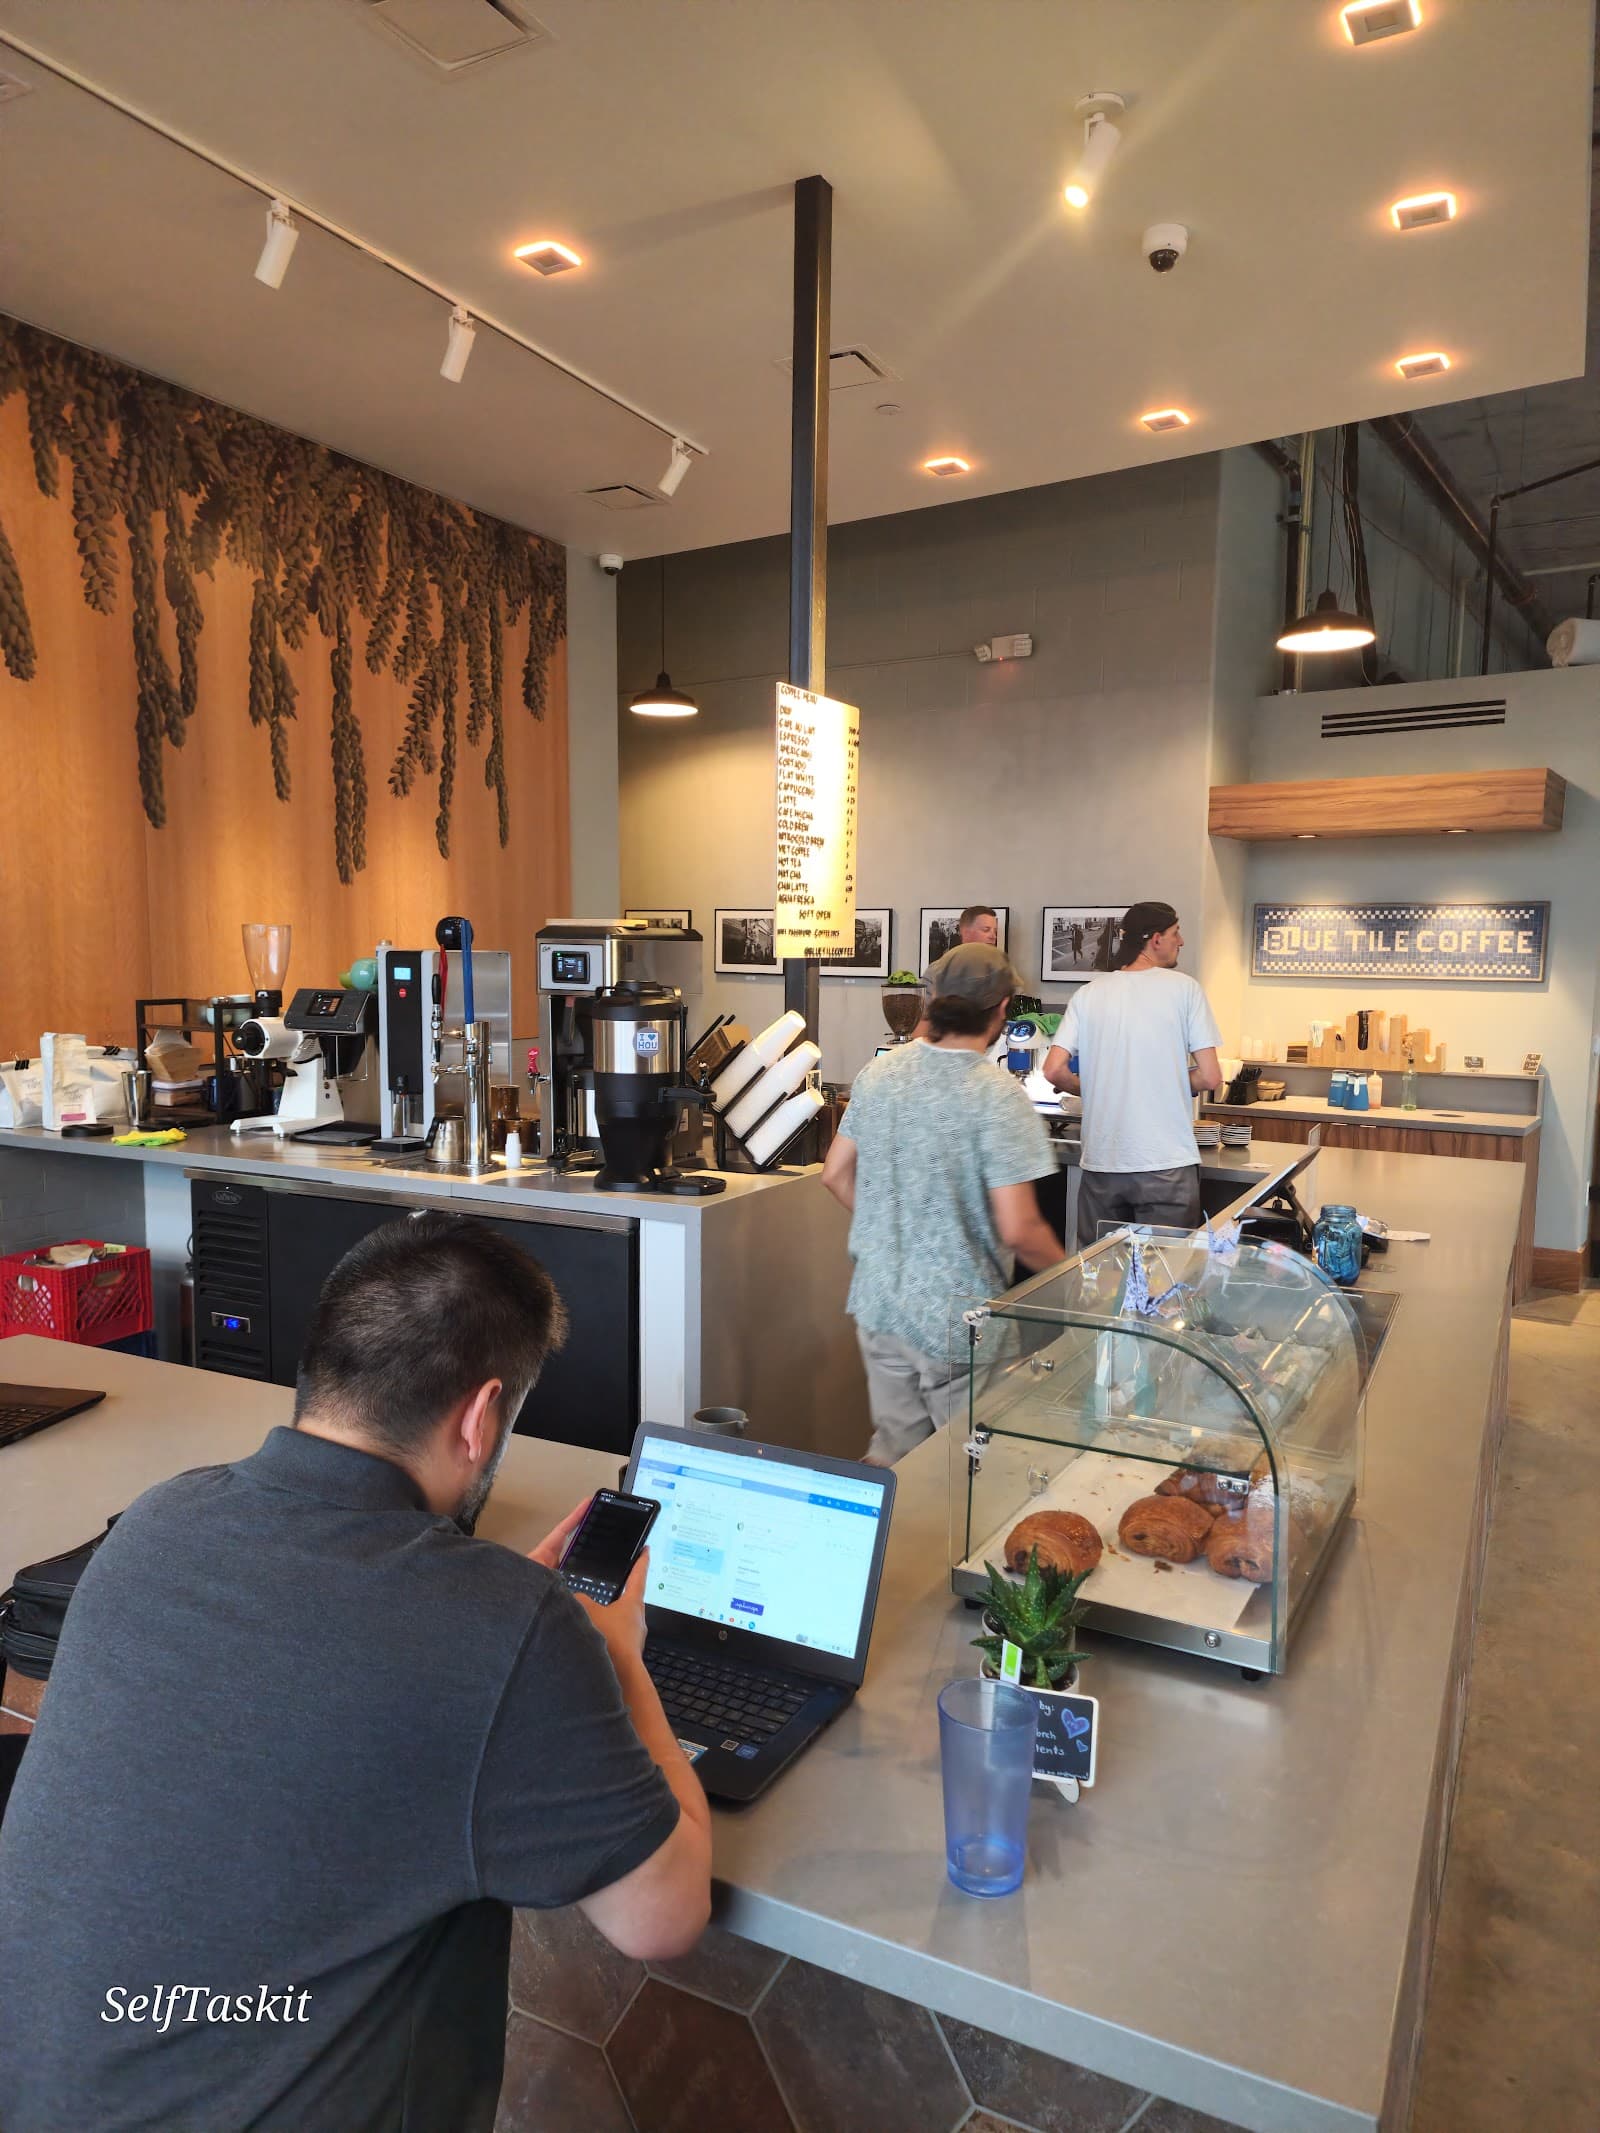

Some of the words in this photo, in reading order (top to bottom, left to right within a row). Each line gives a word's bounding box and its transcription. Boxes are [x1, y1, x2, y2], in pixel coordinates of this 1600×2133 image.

[1263, 927, 1340, 955] BLUE
[1343, 930, 1410, 952] TILE
[1416, 930, 1534, 953] COFFEE
